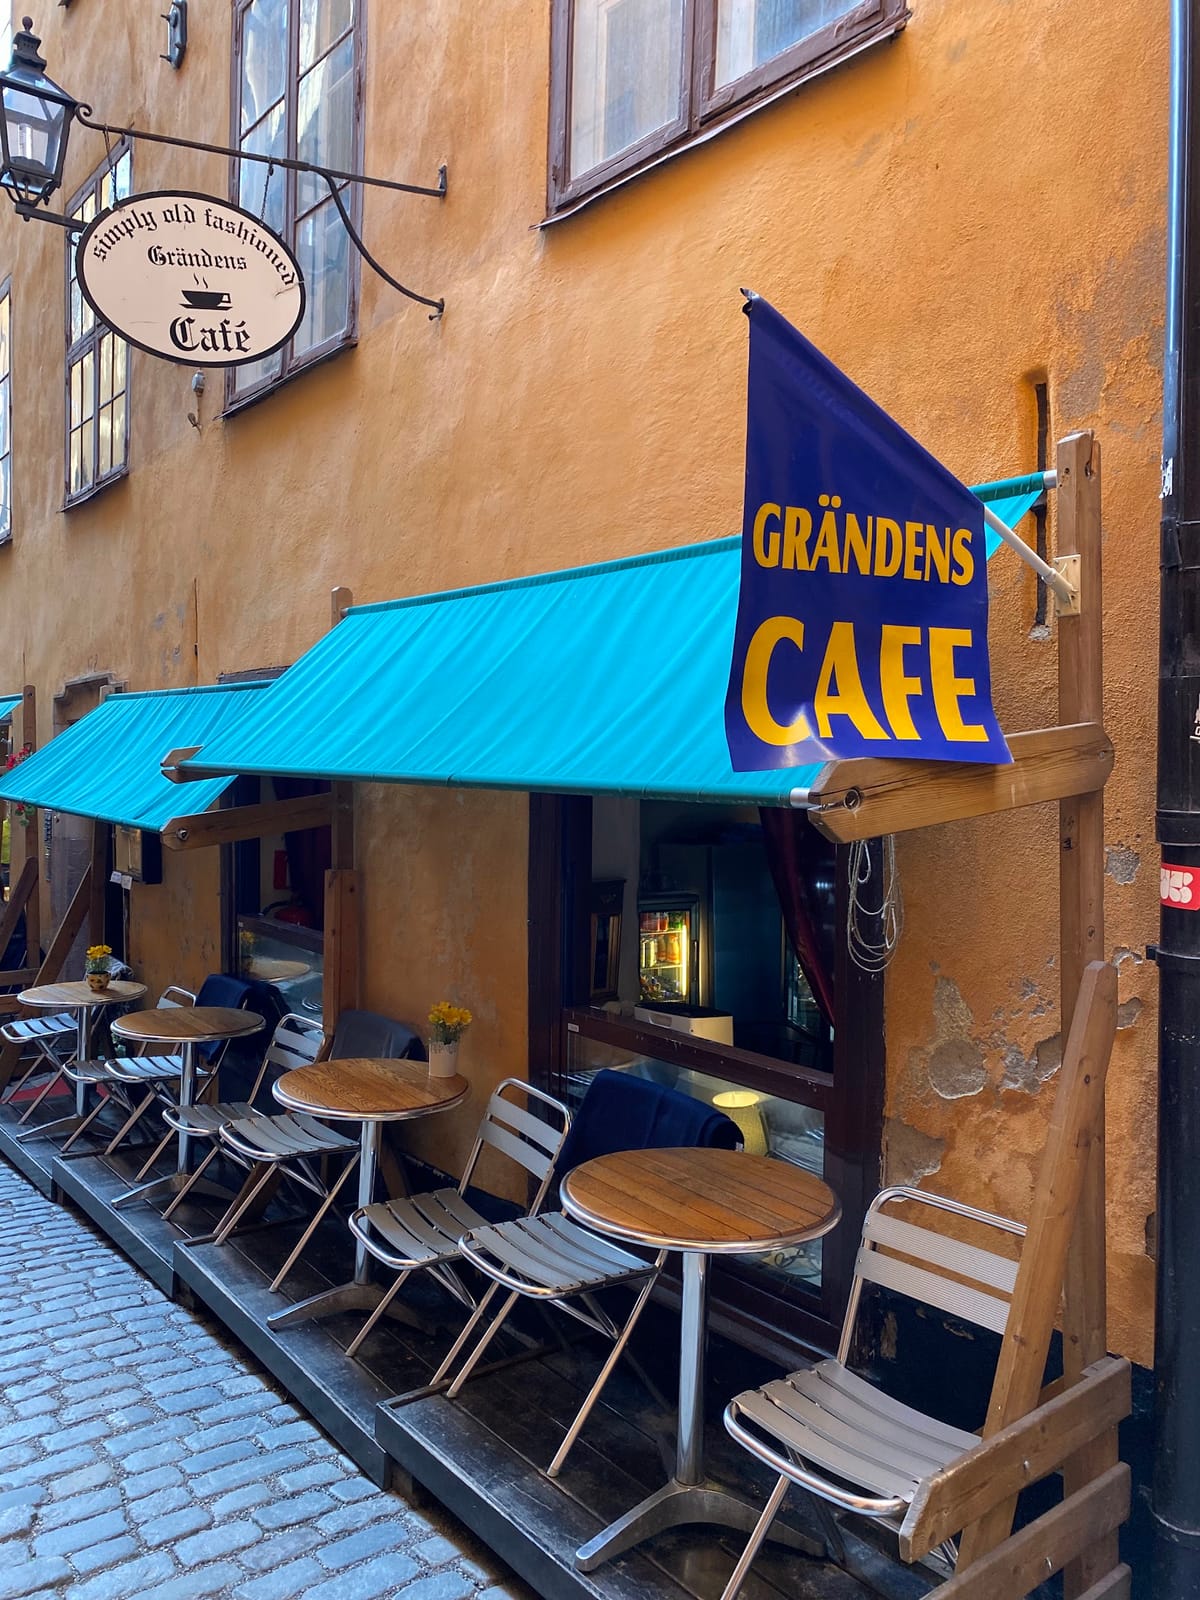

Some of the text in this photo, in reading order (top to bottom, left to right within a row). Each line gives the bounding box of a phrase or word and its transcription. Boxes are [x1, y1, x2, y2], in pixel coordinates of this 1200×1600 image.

[93, 204, 296, 286] simply old fashioned
[147, 245, 248, 271] Grändens
[169, 316, 252, 353] Café
[752, 494, 975, 586] GRÄNDENS
[741, 616, 990, 746] CAFE
